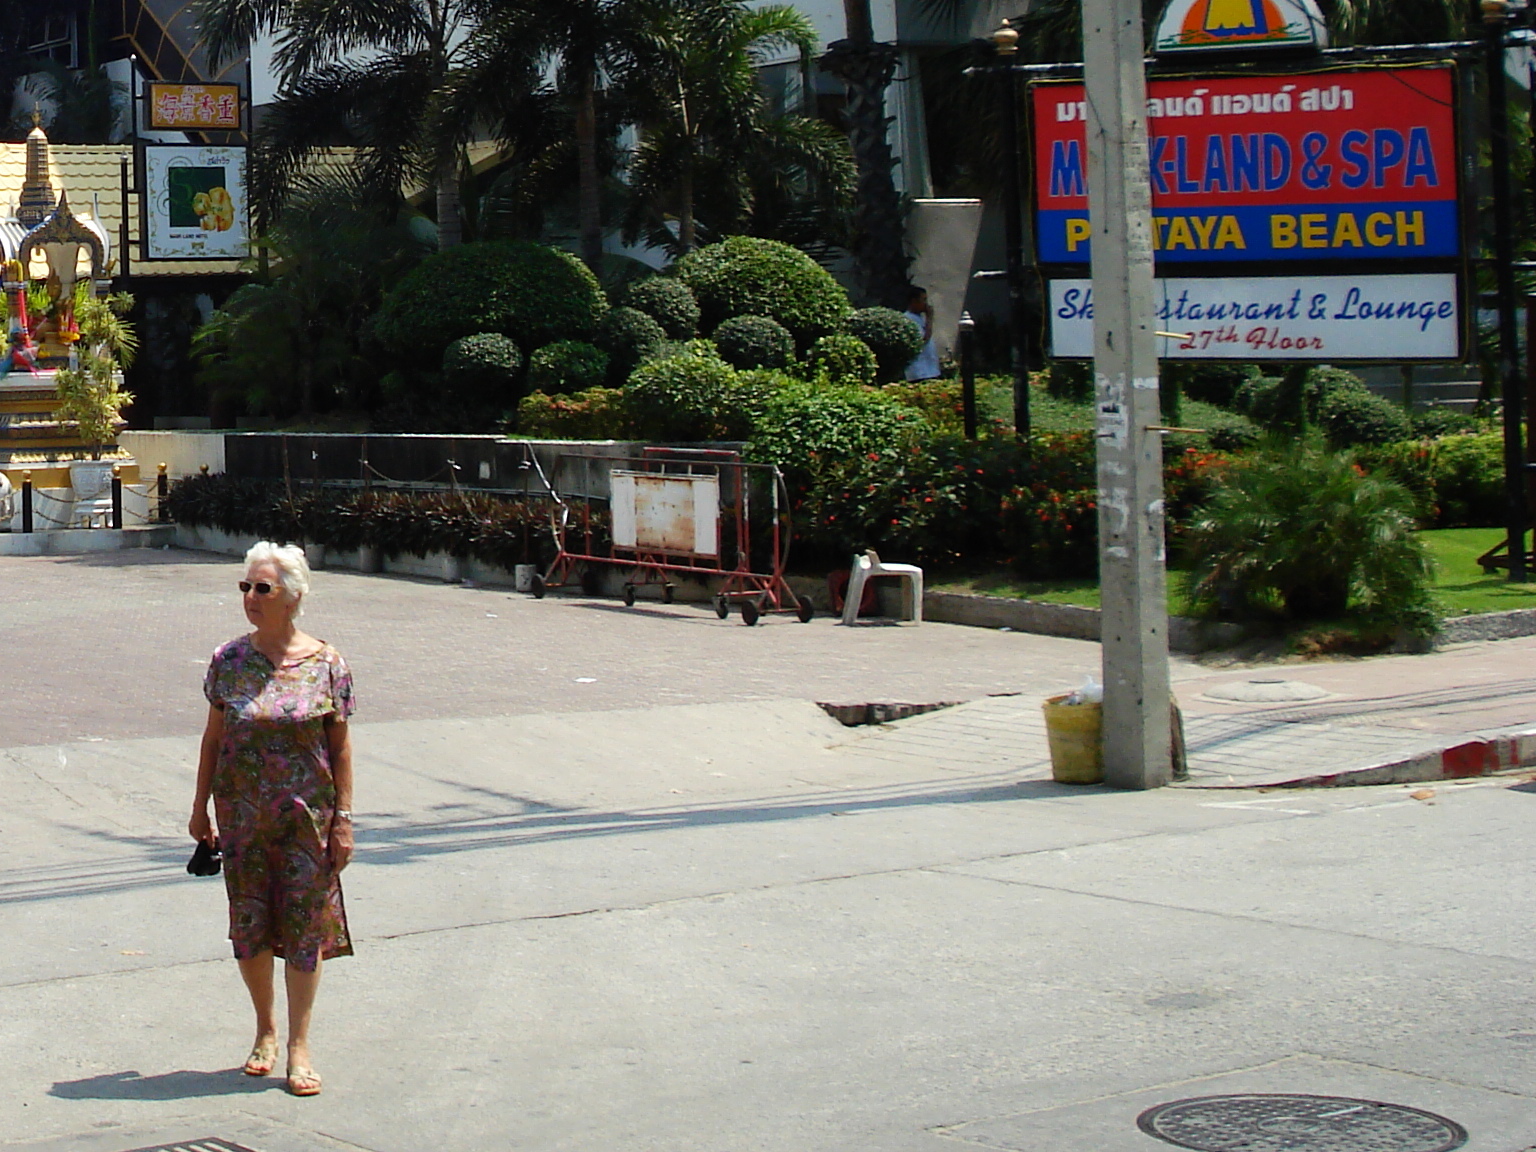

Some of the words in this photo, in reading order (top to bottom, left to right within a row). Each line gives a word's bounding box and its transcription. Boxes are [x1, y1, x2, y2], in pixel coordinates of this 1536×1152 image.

[1056, 88, 1210, 122] มาลนด์
[1210, 84, 1296, 115] แอนด์
[1300, 85, 1354, 111] สปา
[1049, 132, 1292, 197] MK-LAND
[1300, 131, 1333, 190] &
[1339, 126, 1440, 189] SPA
[1066, 215, 1247, 252] PTAYA
[1271, 210, 1425, 249] BEACH
[1057, 288, 1095, 320] Sk
[1154, 288, 1302, 320] staurant
[1308, 293, 1328, 320] &
[1334, 287, 1454, 332] Lounge
[1179, 324, 1240, 350] 27th
[1245, 326, 1324, 350] Floor
